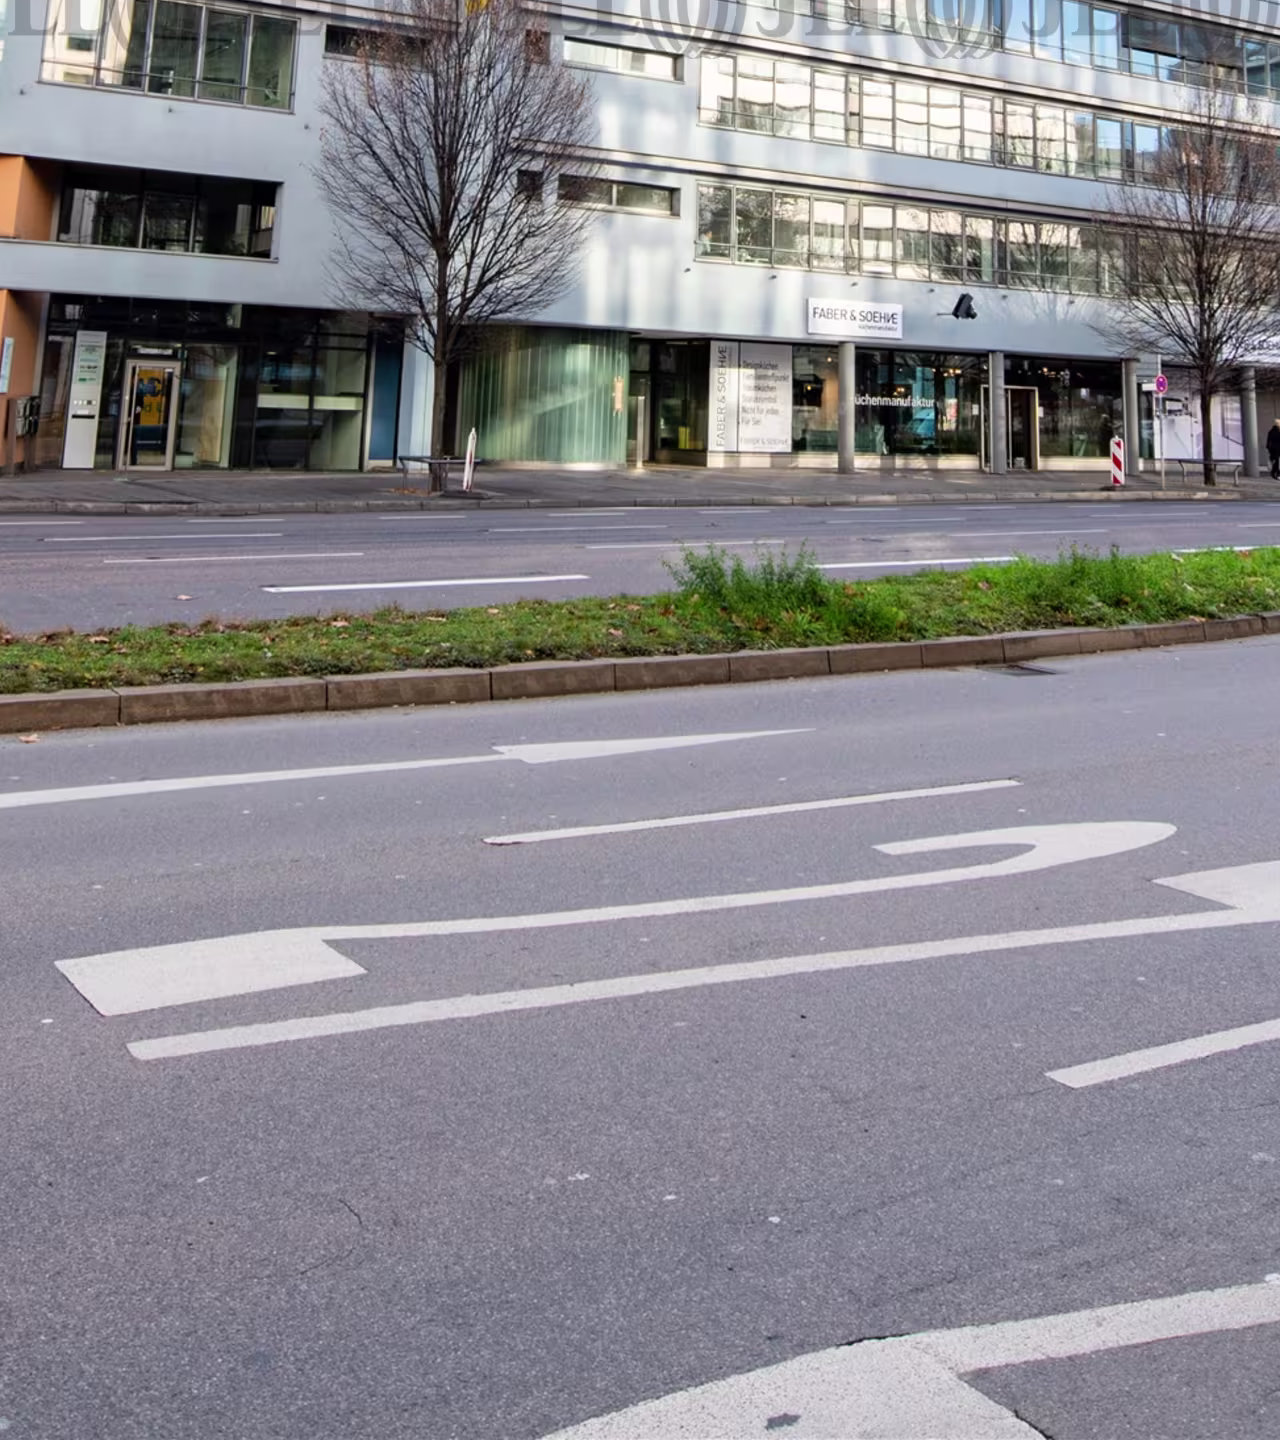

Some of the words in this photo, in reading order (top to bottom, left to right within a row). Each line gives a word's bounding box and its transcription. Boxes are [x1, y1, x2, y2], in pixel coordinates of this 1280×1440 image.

[813, 306, 848, 320] FABER
[849, 309, 857, 321] &
[858, 310, 898, 325] SOEHNE
[717, 345, 727, 392] SOEHNE
[853, 393, 936, 407] üchenmanufaktur
[716, 407, 727, 447] FABER
